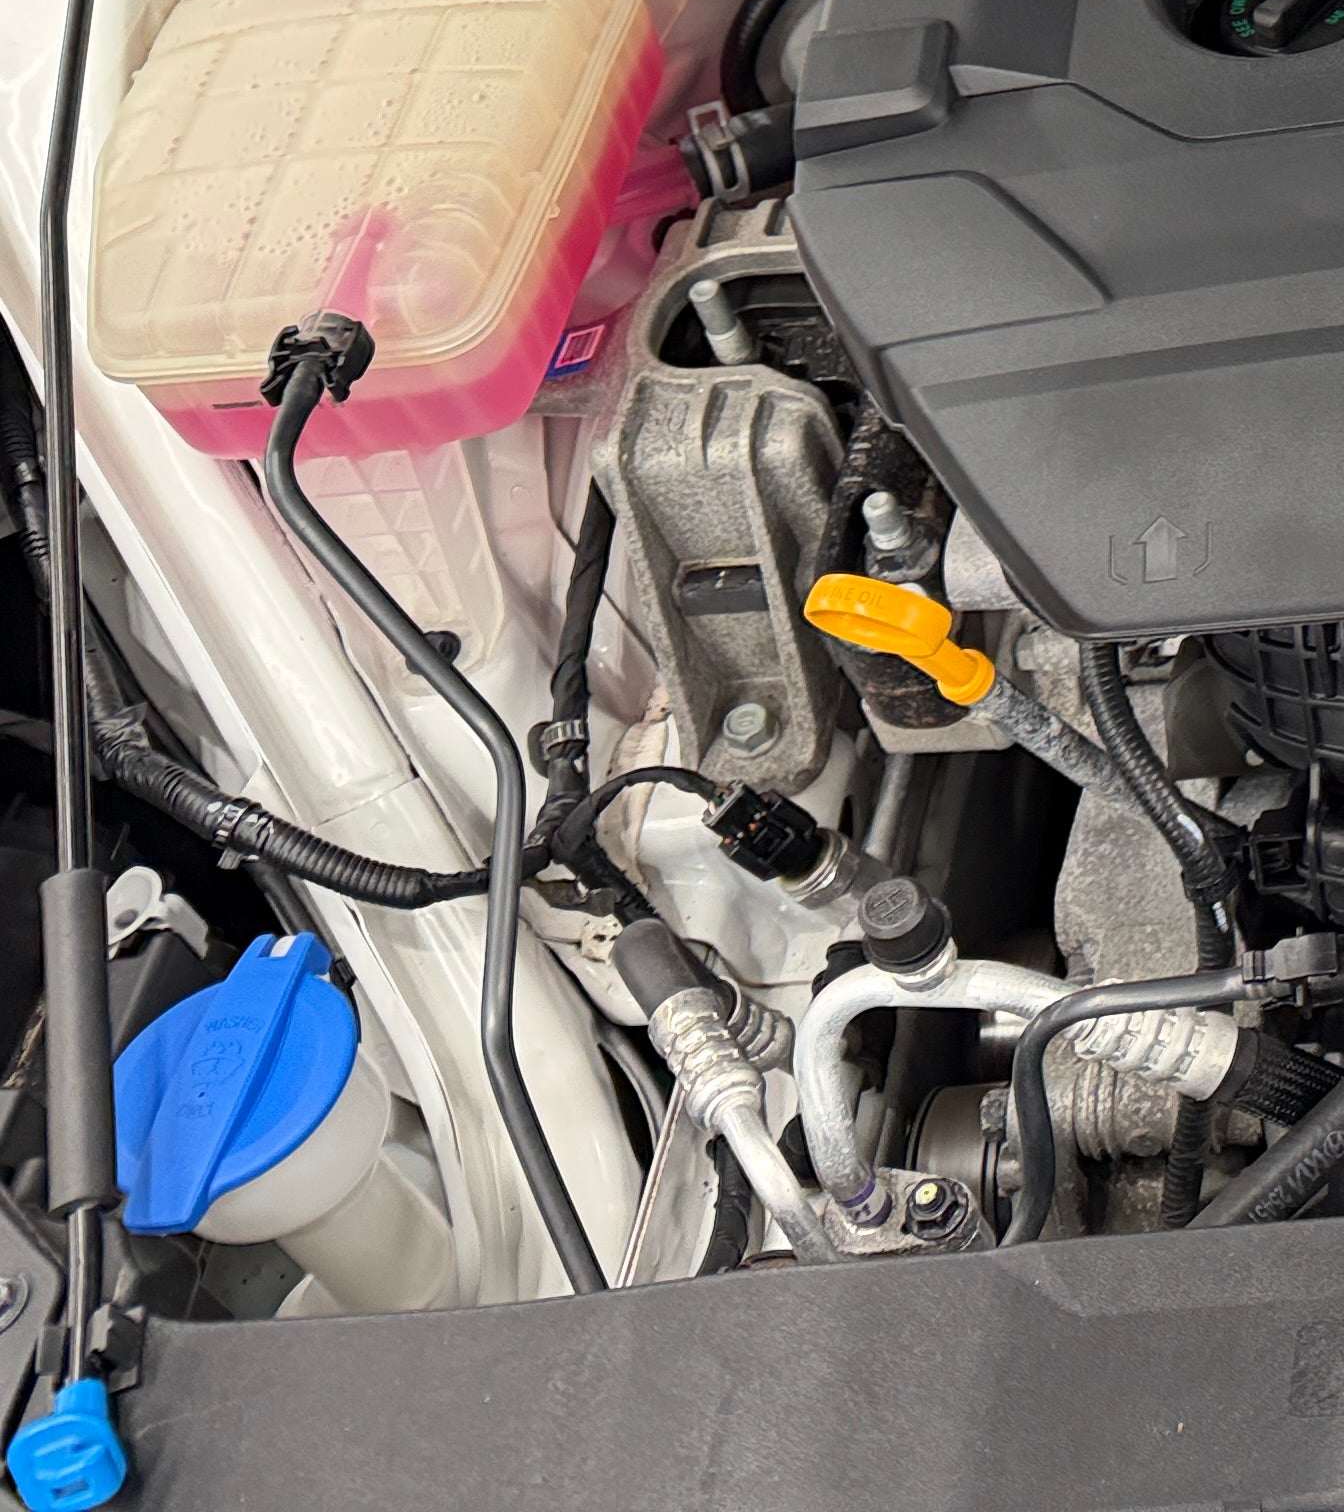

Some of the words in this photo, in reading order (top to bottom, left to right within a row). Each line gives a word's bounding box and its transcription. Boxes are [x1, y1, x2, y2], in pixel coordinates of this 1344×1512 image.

[1231, 18, 1256, 39] SEE
[858, 590, 886, 610] OIL
[204, 1015, 266, 1034] WASHER
